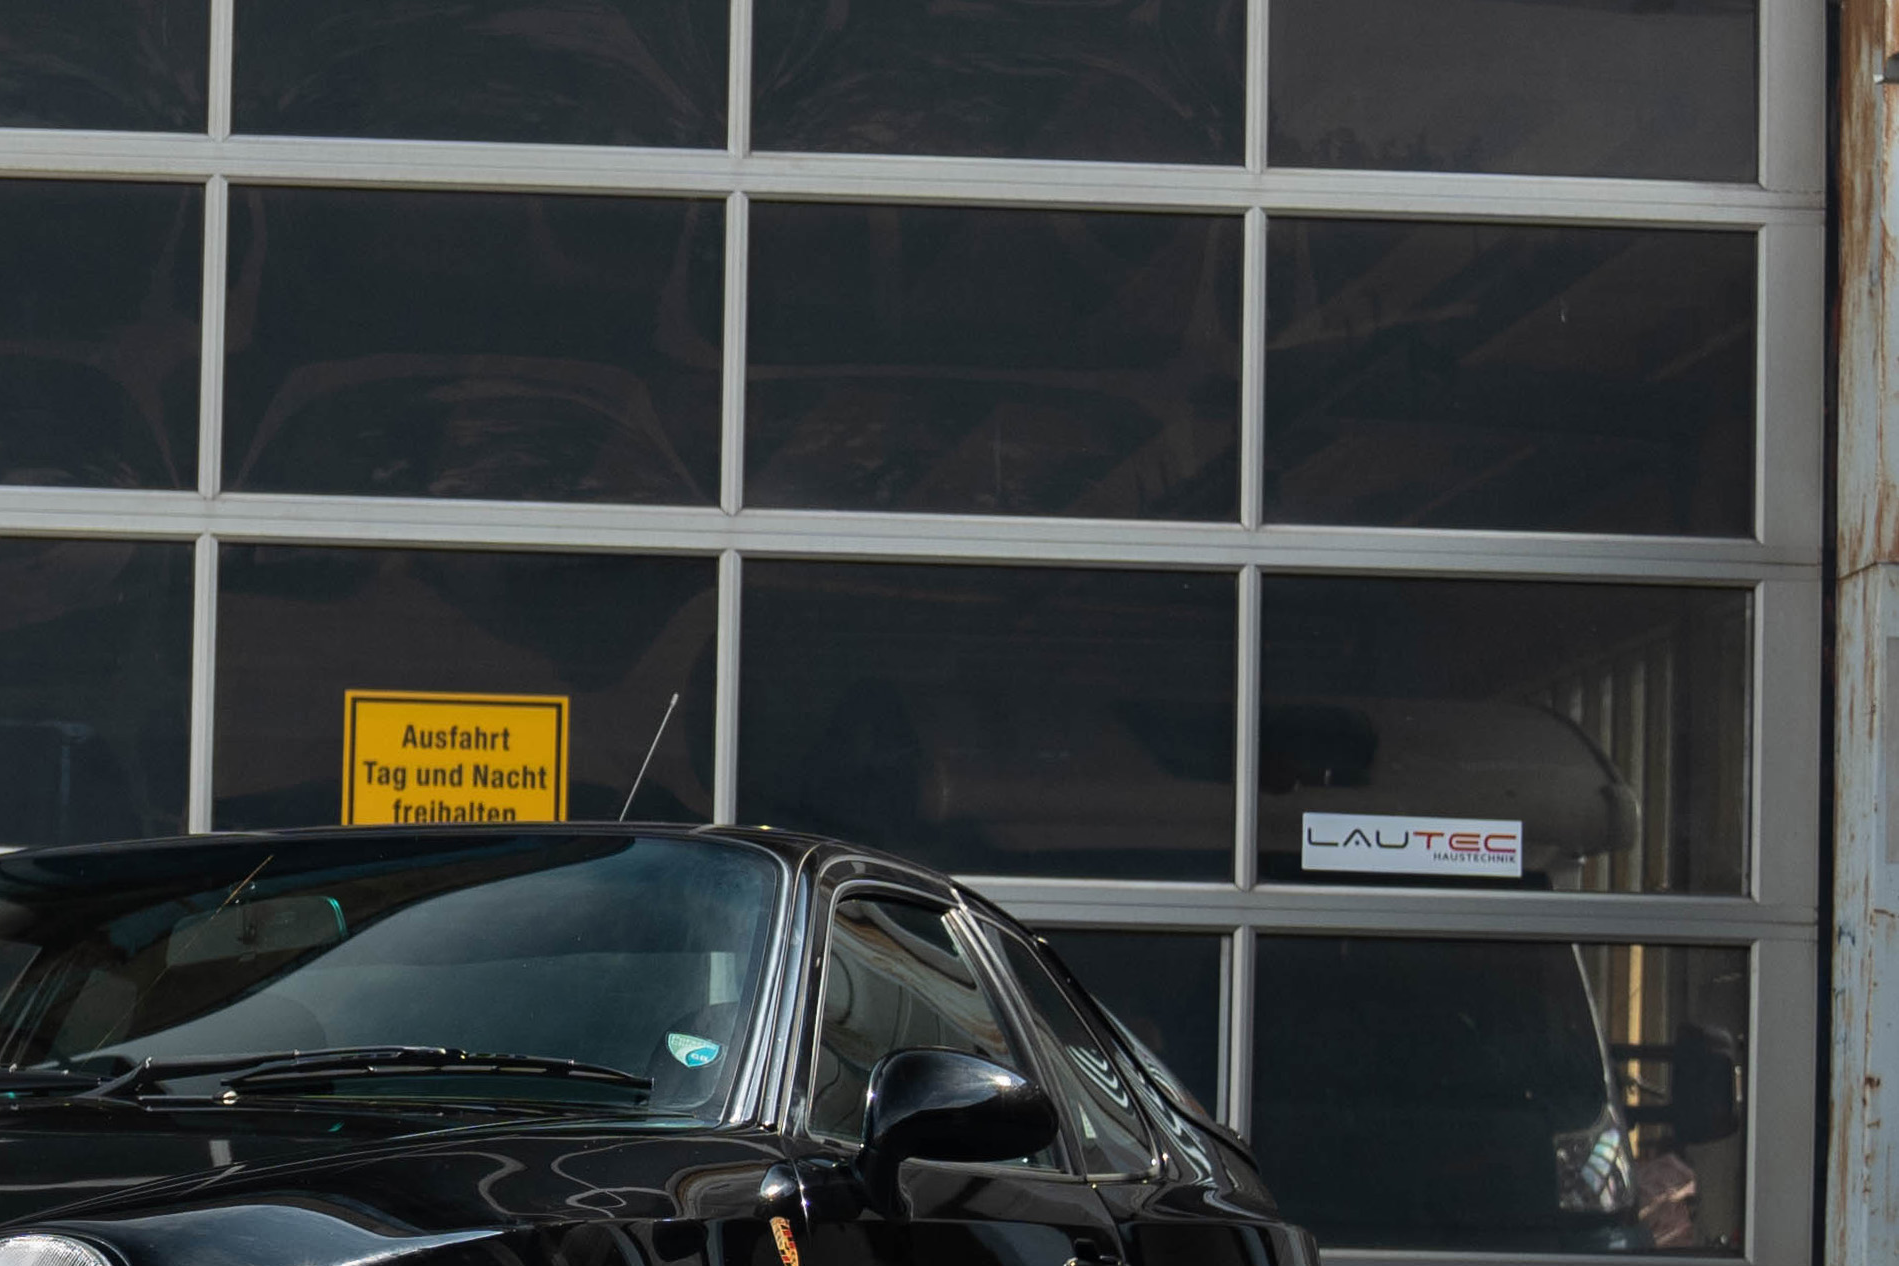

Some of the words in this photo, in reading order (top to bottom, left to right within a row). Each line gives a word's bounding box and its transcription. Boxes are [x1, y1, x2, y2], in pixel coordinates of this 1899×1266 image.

[402, 724, 510, 751] Ausfahrt
[363, 761, 407, 791] Tag
[416, 764, 463, 787] und
[472, 764, 547, 790] Nacht
[393, 798, 516, 823] freihalten
[1307, 827, 1517, 854] LAUTEC
[1433, 853, 1516, 864] HAUSTECHNIK
